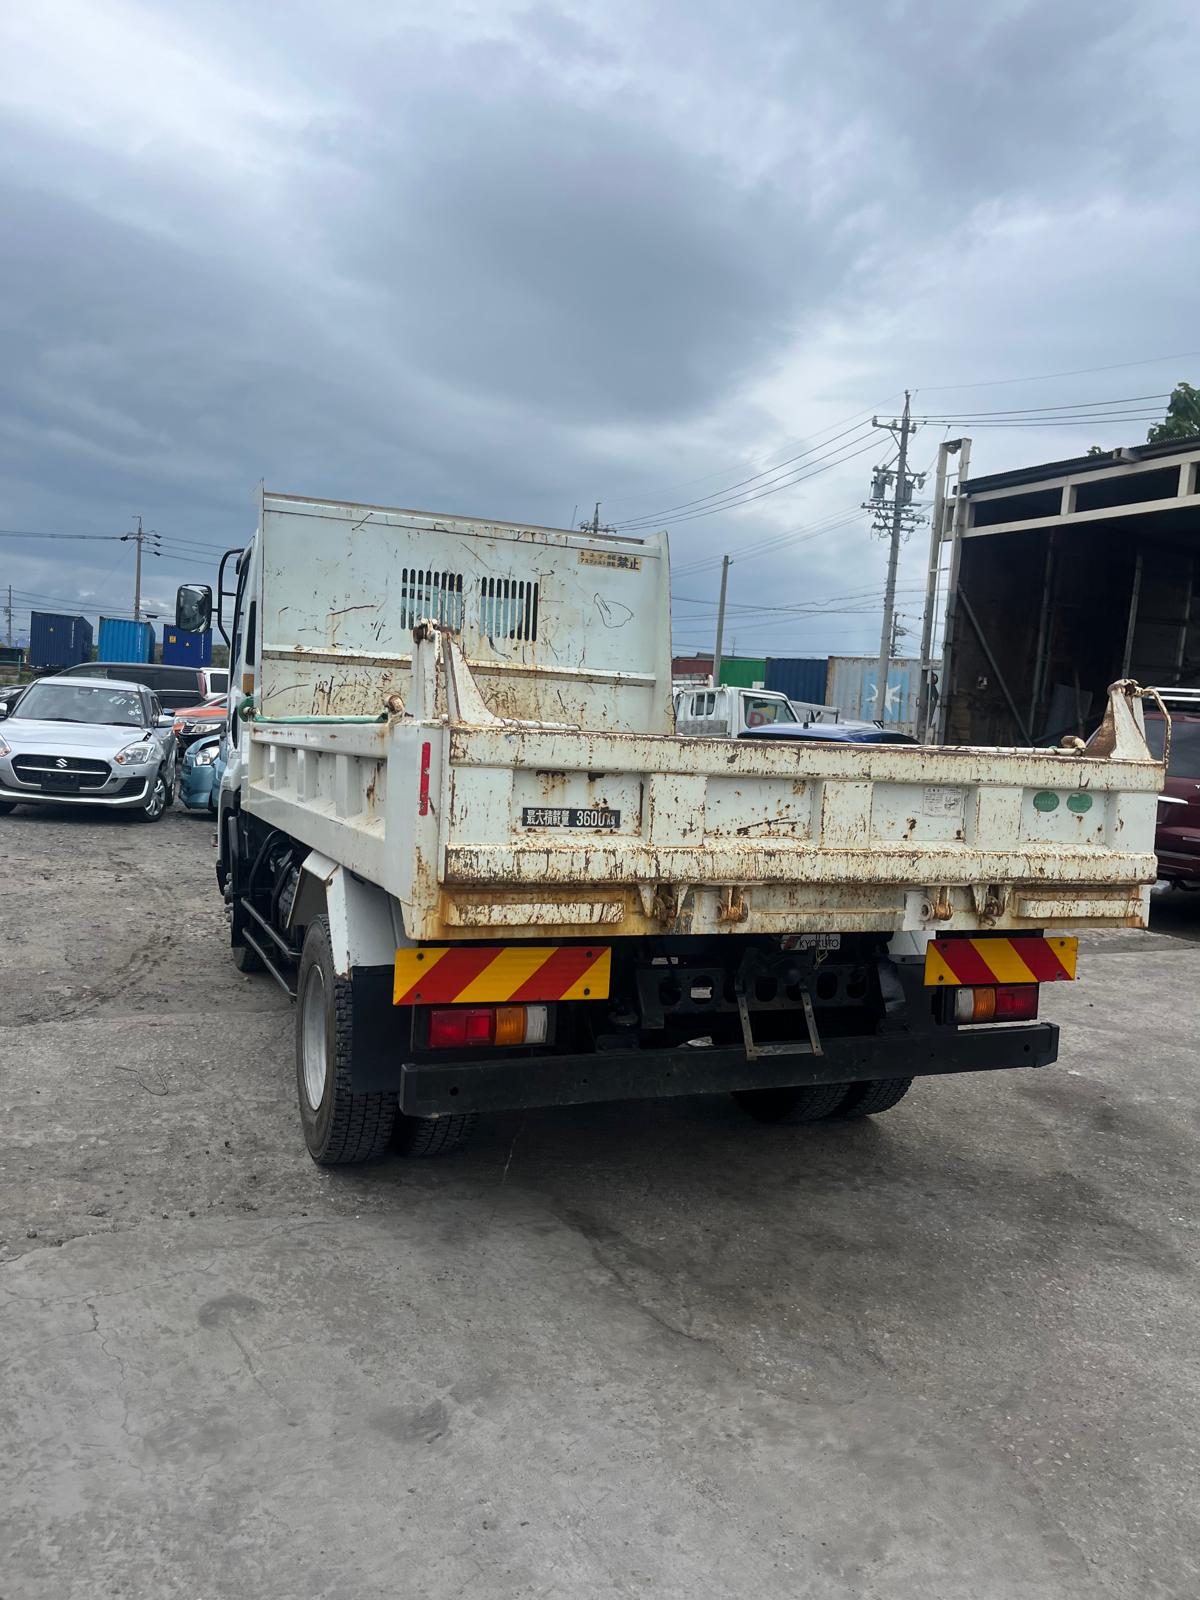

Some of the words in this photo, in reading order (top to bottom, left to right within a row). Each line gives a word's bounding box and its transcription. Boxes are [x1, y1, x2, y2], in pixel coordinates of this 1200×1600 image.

[617, 556, 640, 570] 禁止
[526, 809, 570, 826] 最大積載量
[576, 810, 605, 826] 3600
